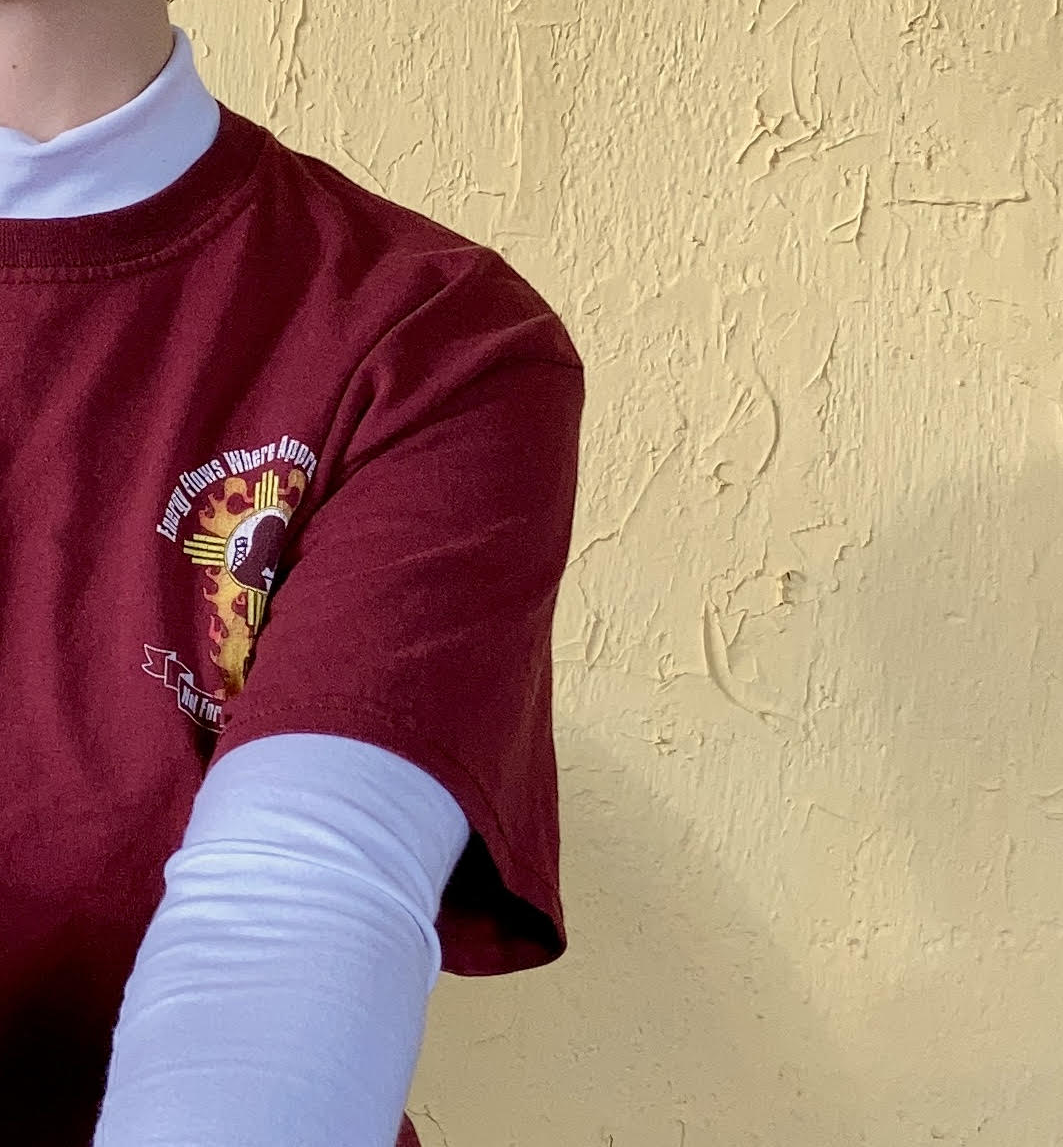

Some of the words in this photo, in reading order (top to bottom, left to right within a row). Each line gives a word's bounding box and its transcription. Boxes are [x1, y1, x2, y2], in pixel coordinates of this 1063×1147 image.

[156, 485, 192, 543] Energy
[179, 470, 226, 498] Flows
[223, 442, 276, 475] Where
[277, 435, 317, 483] Appre
[199, 697, 224, 727] For
